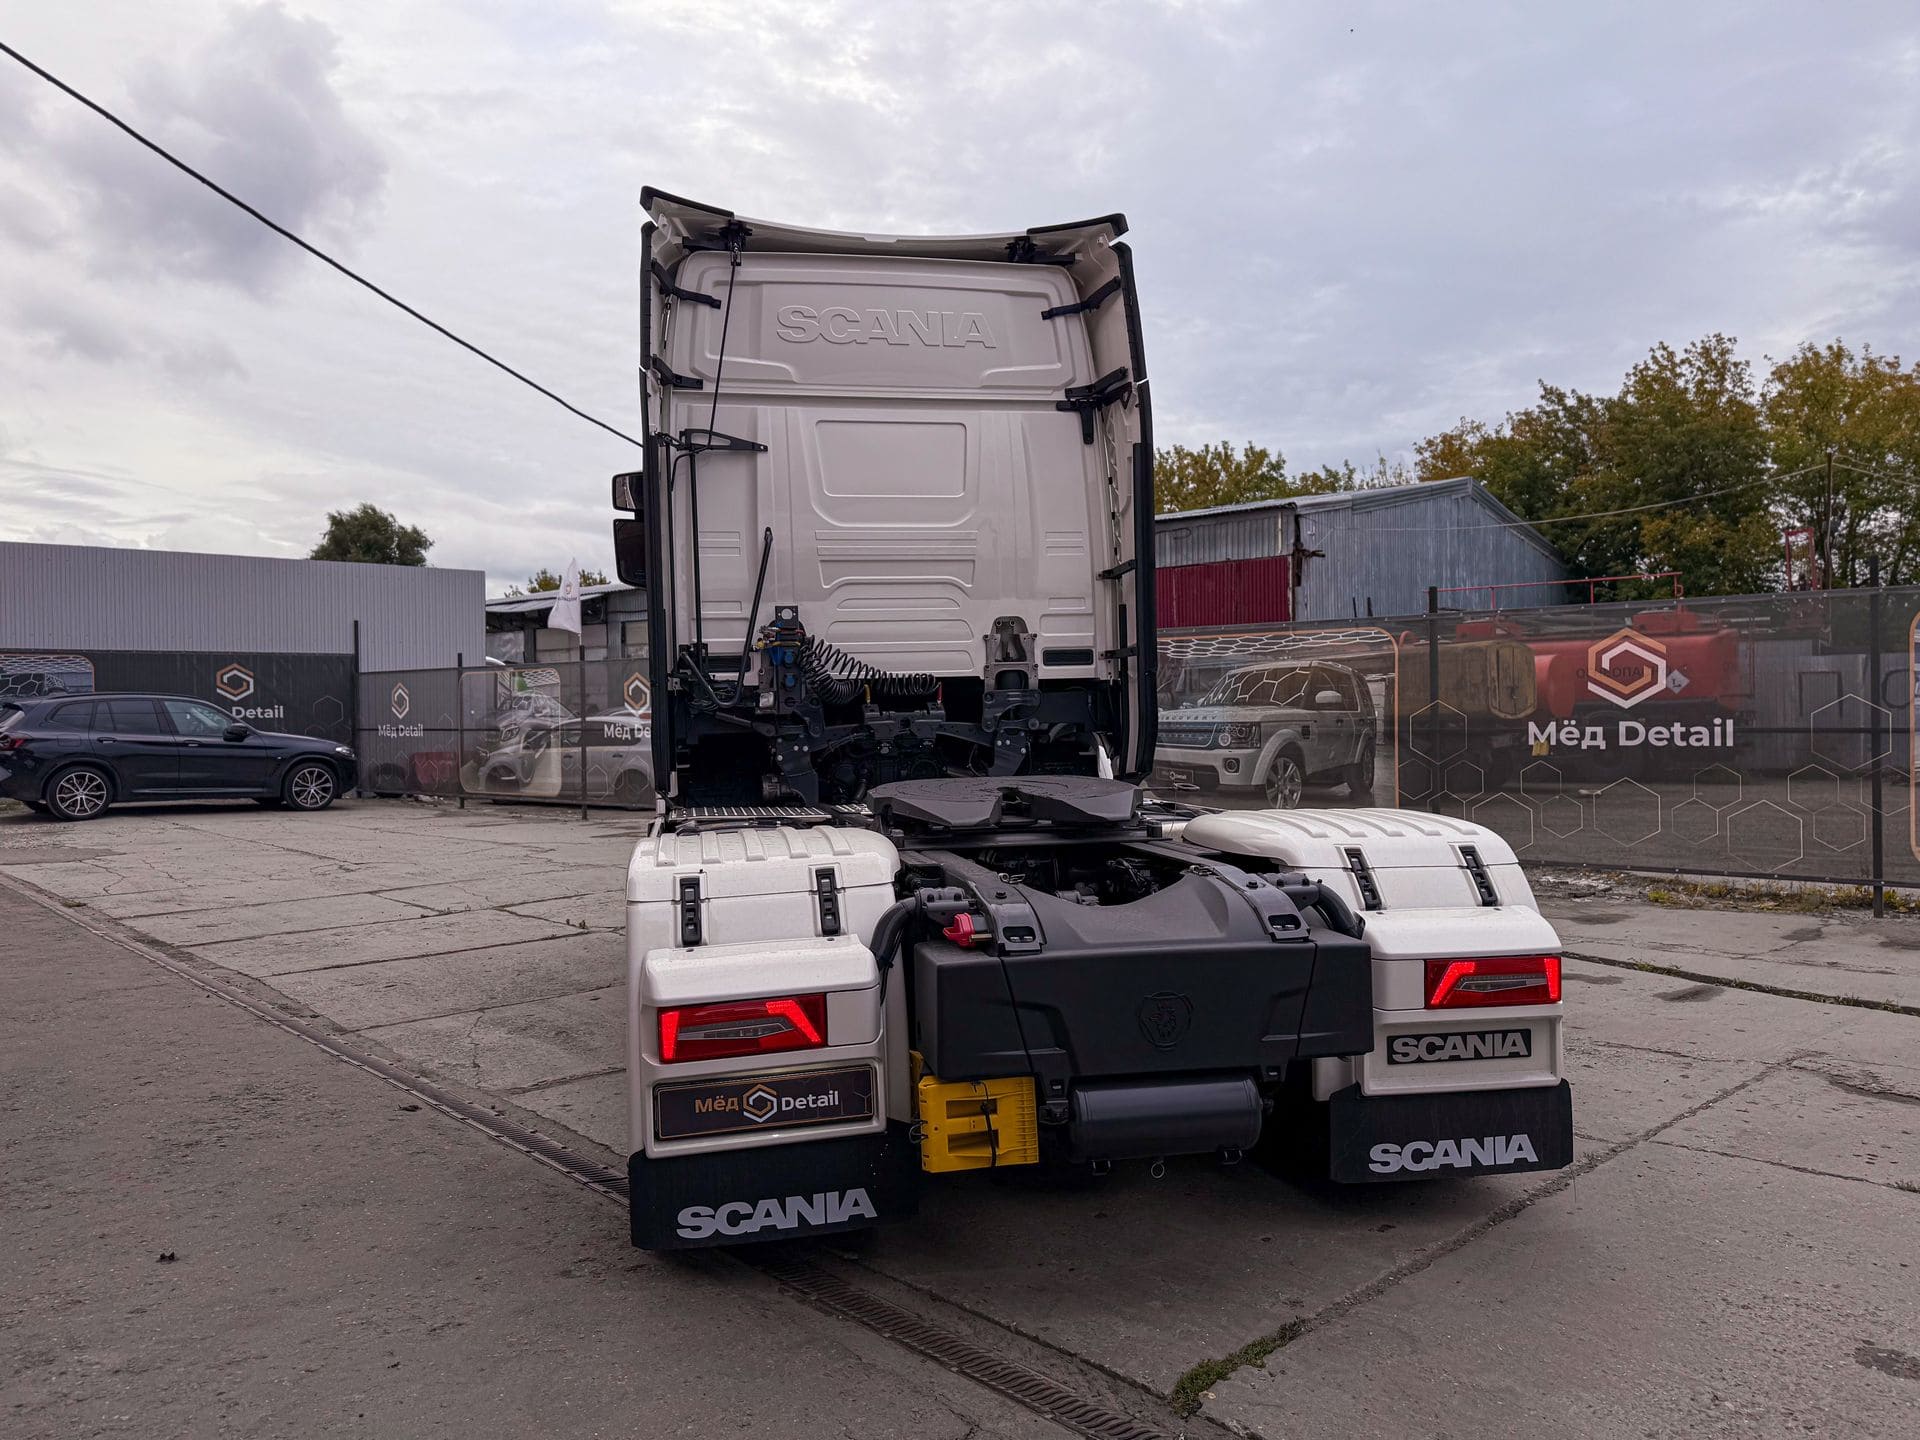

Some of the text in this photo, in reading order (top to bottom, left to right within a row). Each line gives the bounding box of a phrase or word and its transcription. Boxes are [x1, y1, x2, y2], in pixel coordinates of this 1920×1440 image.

[776, 305, 997, 349] SCANIA
[231, 704, 284, 719] Detail
[377, 723, 424, 739] Мёд Detail
[603, 721, 631, 740] Мёд
[1528, 717, 1734, 749] Мёд Detail
[1392, 1032, 1529, 1062] SCANIA
[695, 1090, 839, 1113] Мёд Detail
[1368, 1133, 1539, 1173] SCANIA
[676, 1187, 878, 1239] SCANIA
